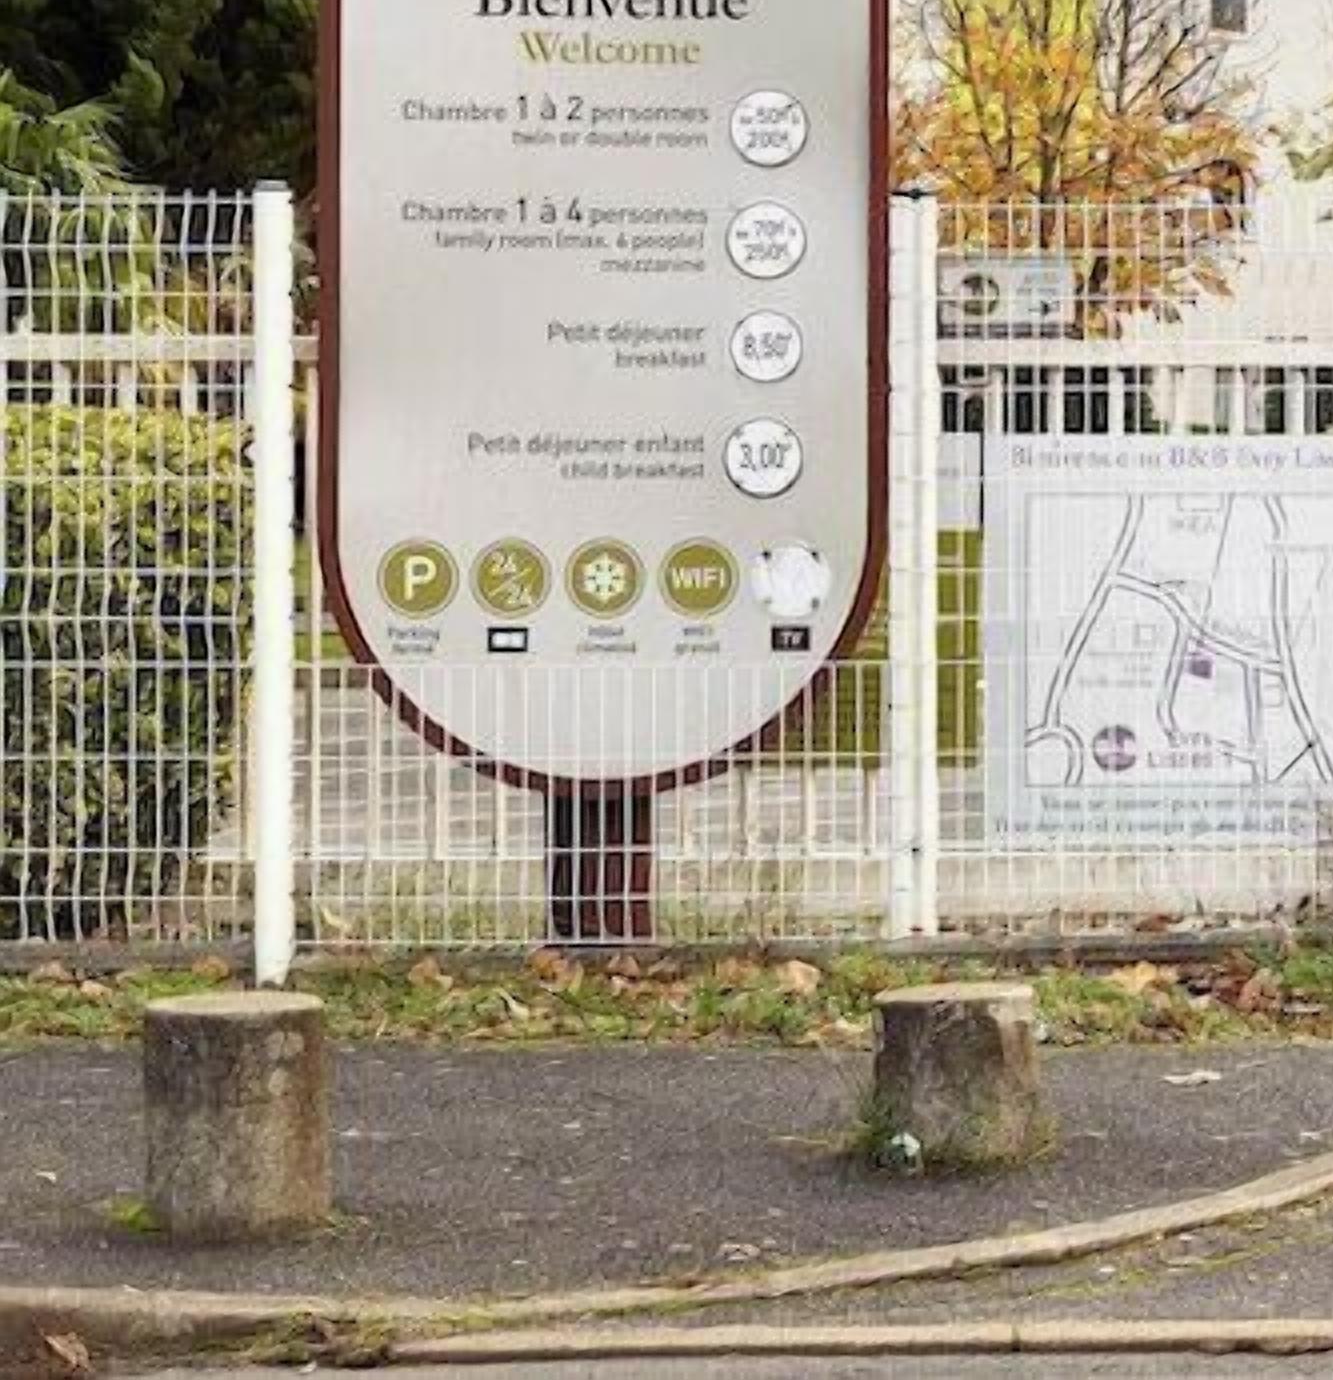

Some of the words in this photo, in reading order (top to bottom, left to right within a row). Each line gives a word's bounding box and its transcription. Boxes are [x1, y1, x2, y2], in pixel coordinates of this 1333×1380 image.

[520, 31, 700, 64] Welcome
[401, 98, 507, 121] Chambre
[517, 95, 528, 121] 1
[540, 93, 557, 121] à
[568, 96, 584, 121] 2
[592, 106, 708, 124] personnes
[401, 201, 507, 222] Chambre
[517, 197, 528, 223] 1
[540, 196, 557, 224] à
[567, 198, 583, 223] 4
[588, 208, 708, 227] personnes
[403, 555, 438, 601] P
[672, 567, 724, 590] WIFI
